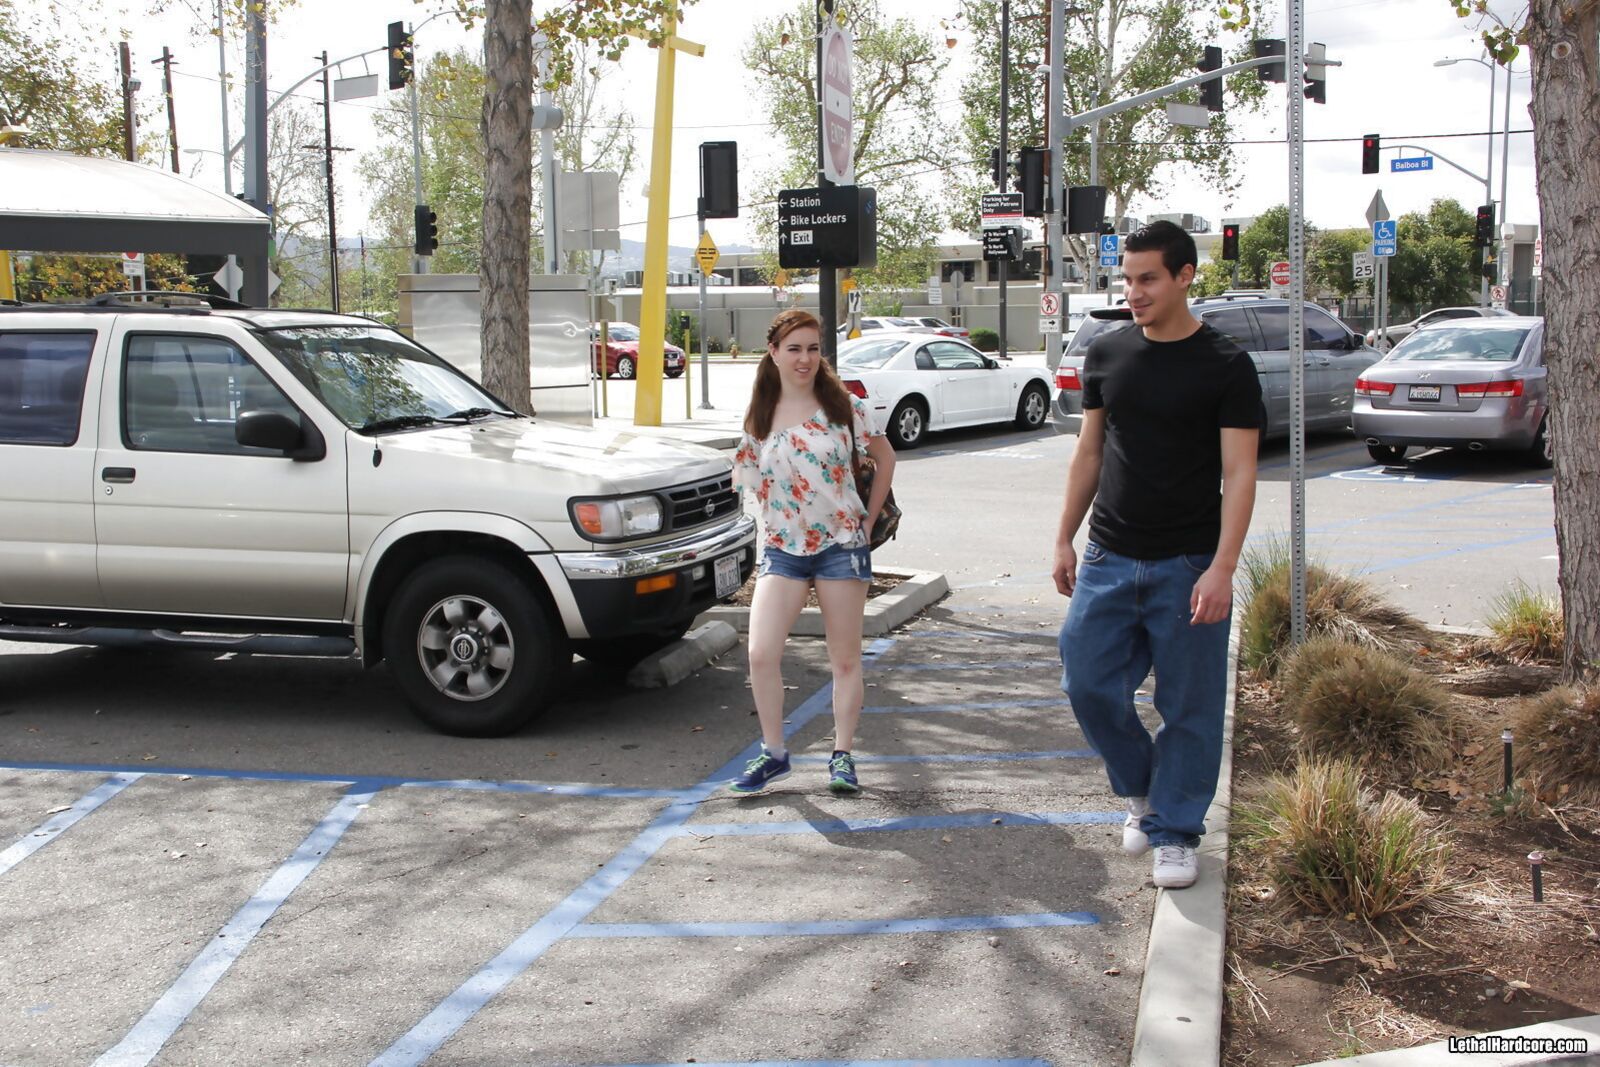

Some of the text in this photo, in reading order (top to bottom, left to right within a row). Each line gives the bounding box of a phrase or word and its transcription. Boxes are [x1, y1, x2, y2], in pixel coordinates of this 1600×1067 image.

[1395, 160, 1429, 169] Balboa Bl
[790, 197, 821, 208] Station
[790, 213, 847, 225] Bike Lockers
[793, 232, 810, 243] Exit
[1355, 265, 1373, 277] 25
